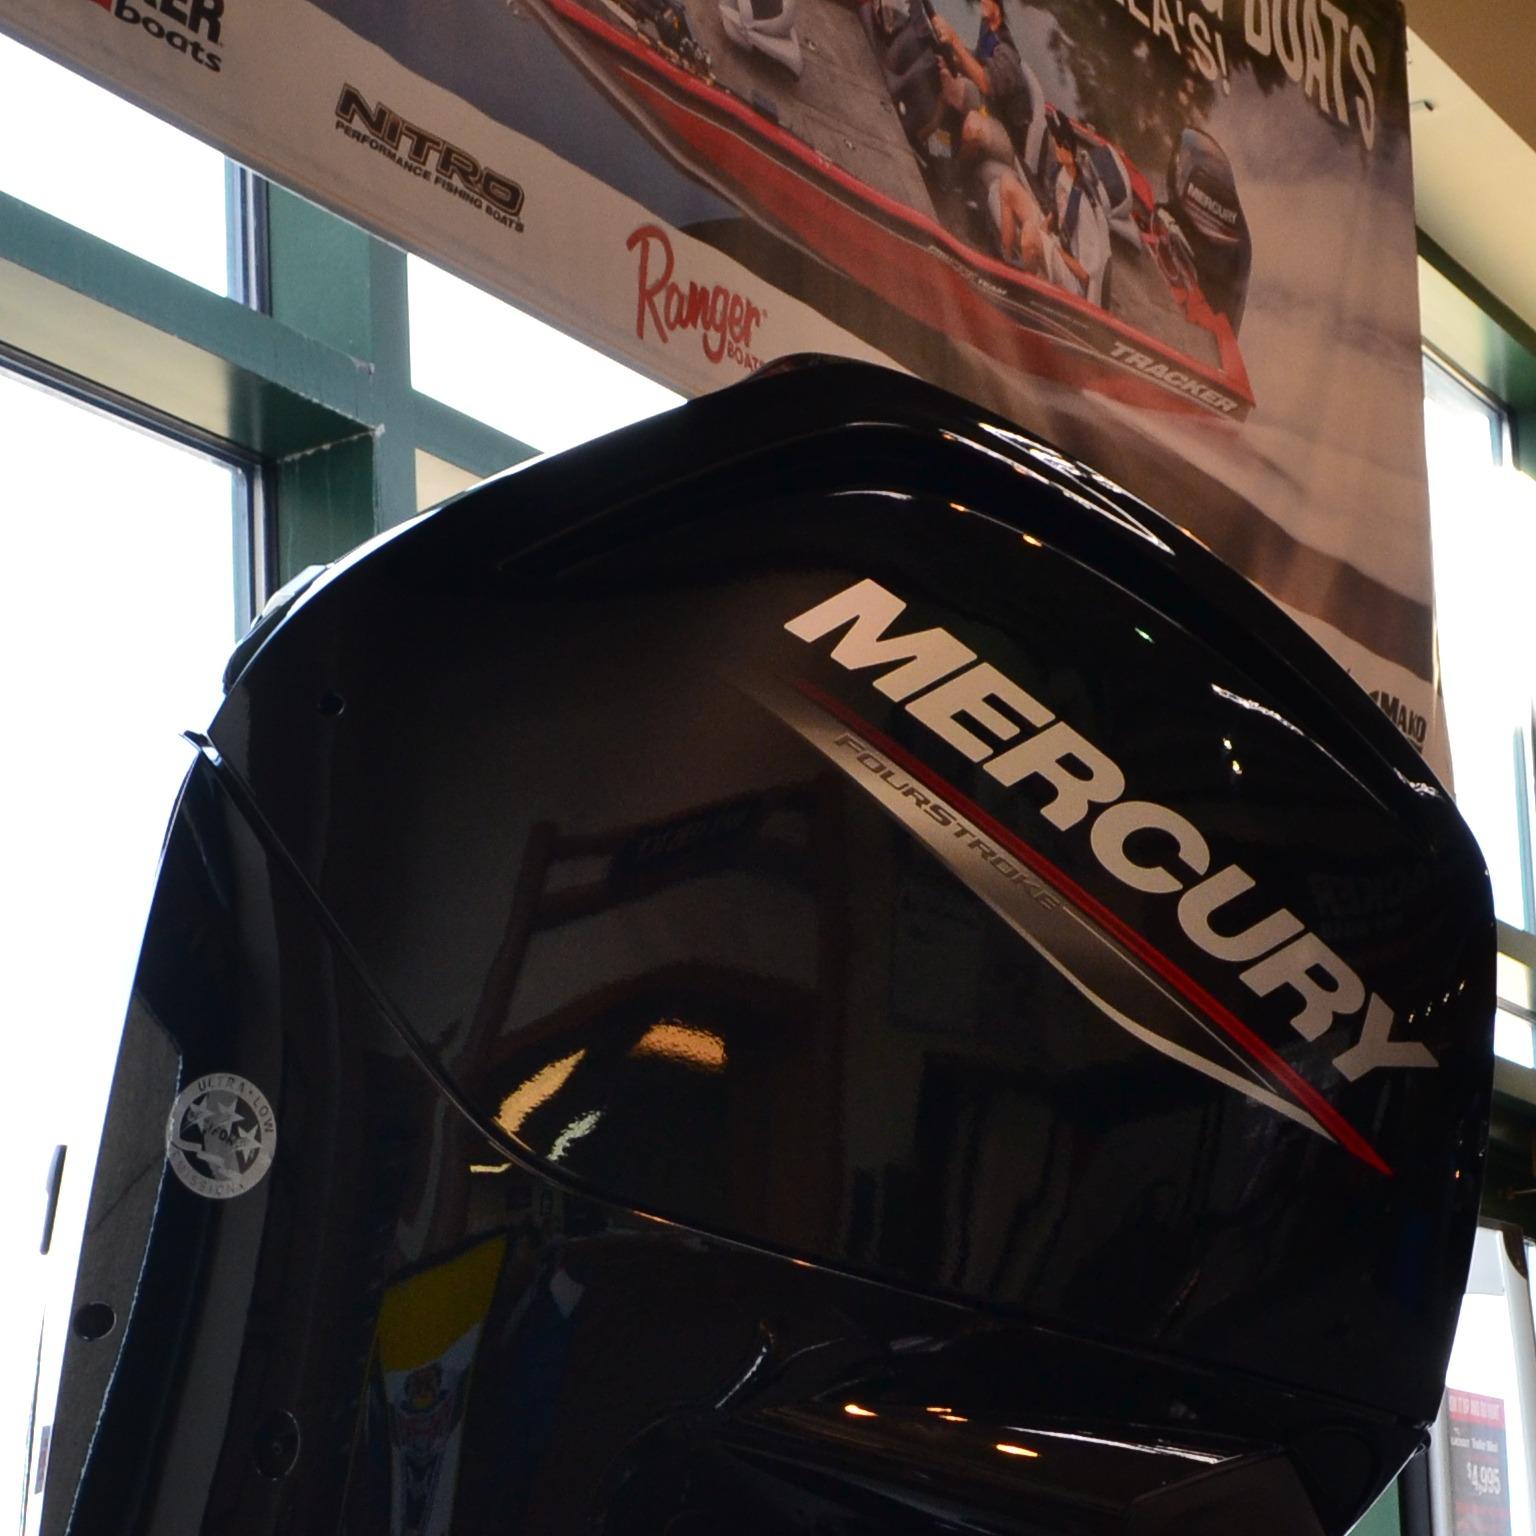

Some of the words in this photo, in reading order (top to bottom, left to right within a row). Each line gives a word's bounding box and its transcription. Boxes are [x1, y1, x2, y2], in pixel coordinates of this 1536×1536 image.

[114, 0, 222, 73] boats
[335, 82, 525, 217] NITRO
[335, 119, 432, 181] PERFORMANCE
[434, 175, 483, 209] FISHING
[485, 205, 525, 233] BOATS
[1187, 182, 1238, 225] MERCURY
[626, 224, 761, 364] Ranger
[1109, 341, 1243, 414] TRACKER
[784, 578, 1438, 1081] MERCURY
[833, 733, 1064, 912] FOURSTROKE
